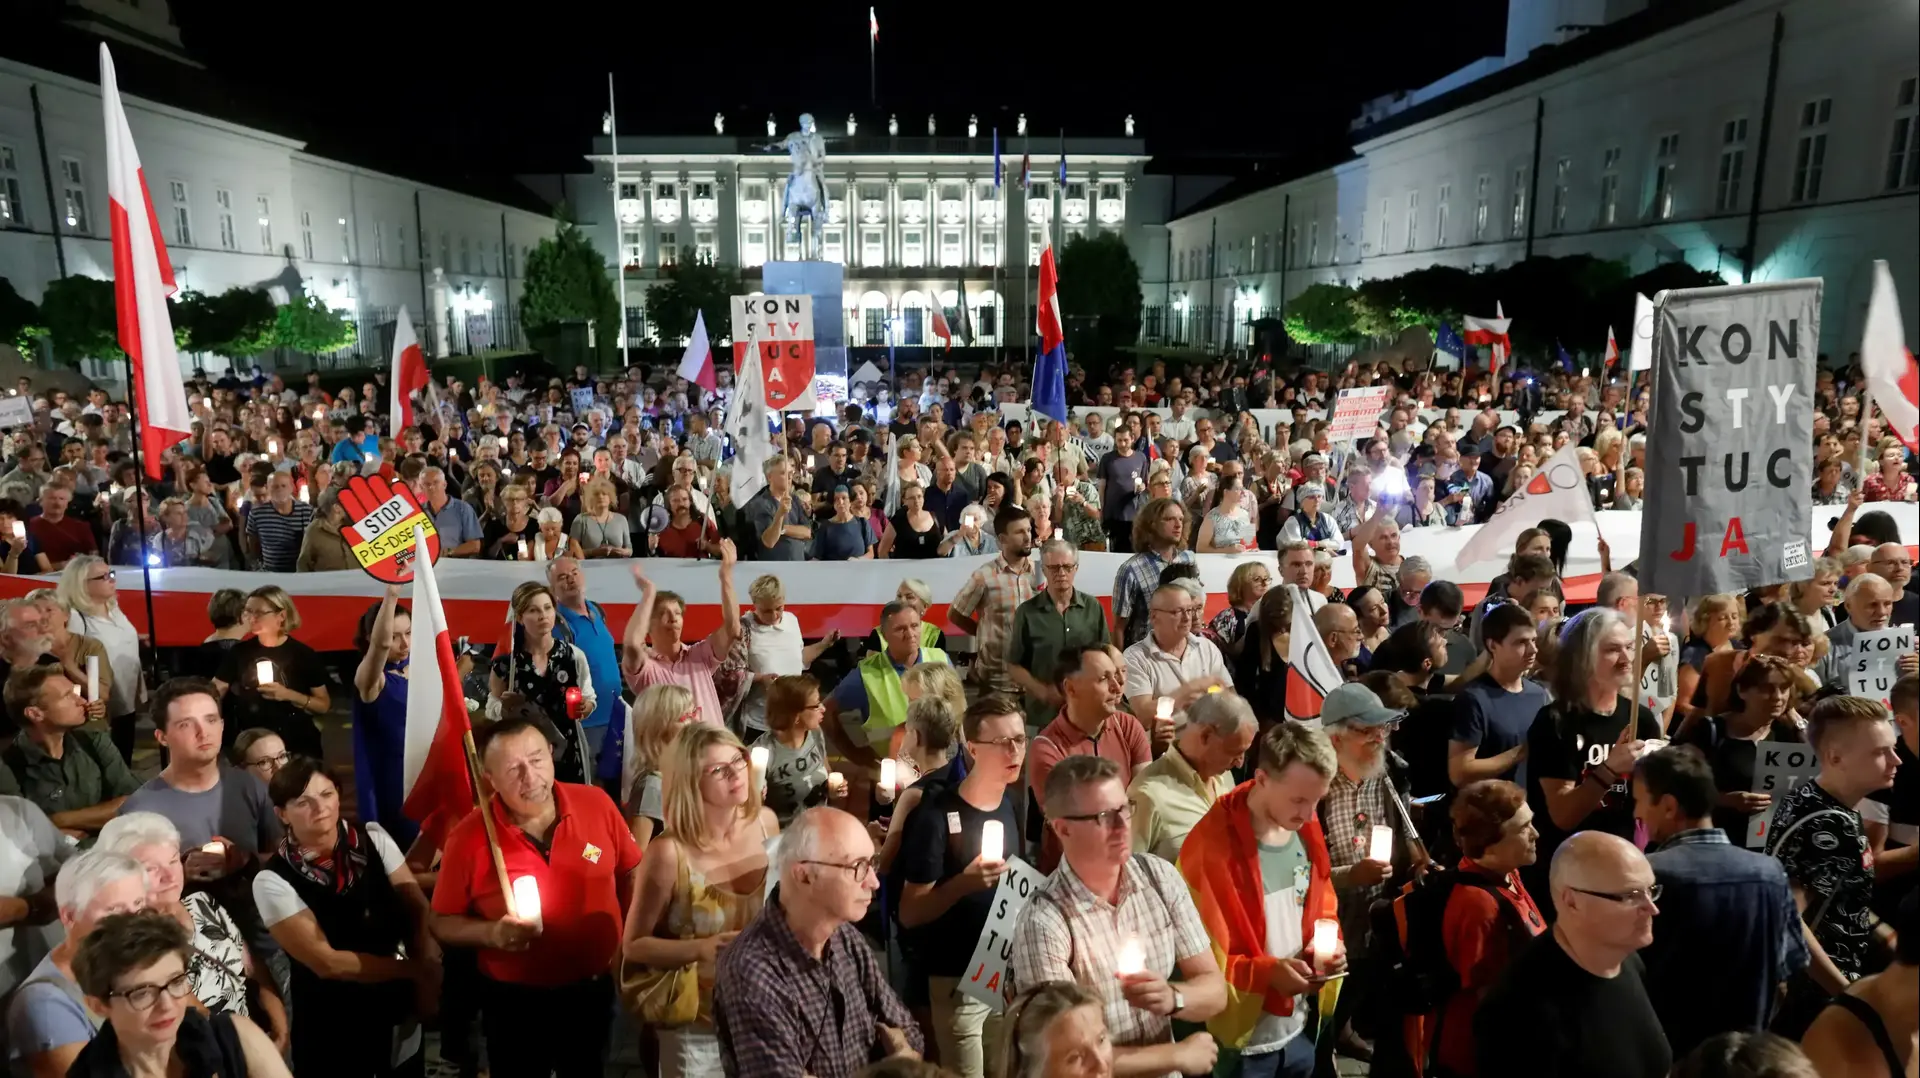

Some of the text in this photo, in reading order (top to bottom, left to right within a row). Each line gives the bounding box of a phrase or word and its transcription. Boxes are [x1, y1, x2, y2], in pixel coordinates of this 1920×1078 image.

[744, 299, 800, 314] KON
[767, 344, 800, 360] UC
[1677, 318, 1798, 367] KON
[768, 367, 783, 382] A
[1679, 383, 1797, 434] STY
[1679, 448, 1792, 496] TUC
[1843, 471, 1858, 487] ON
[364, 500, 402, 534] STOP
[1669, 516, 1750, 562] JA
[1859, 635, 1909, 653] KON
[1857, 656, 1888, 672] ST
[1640, 669, 1658, 690] UC
[1857, 677, 1888, 693] TU
[1762, 775, 1799, 791] ST
[1005, 868, 1030, 898] KO
[987, 929, 1013, 961] TU
[971, 962, 1000, 993] JA
